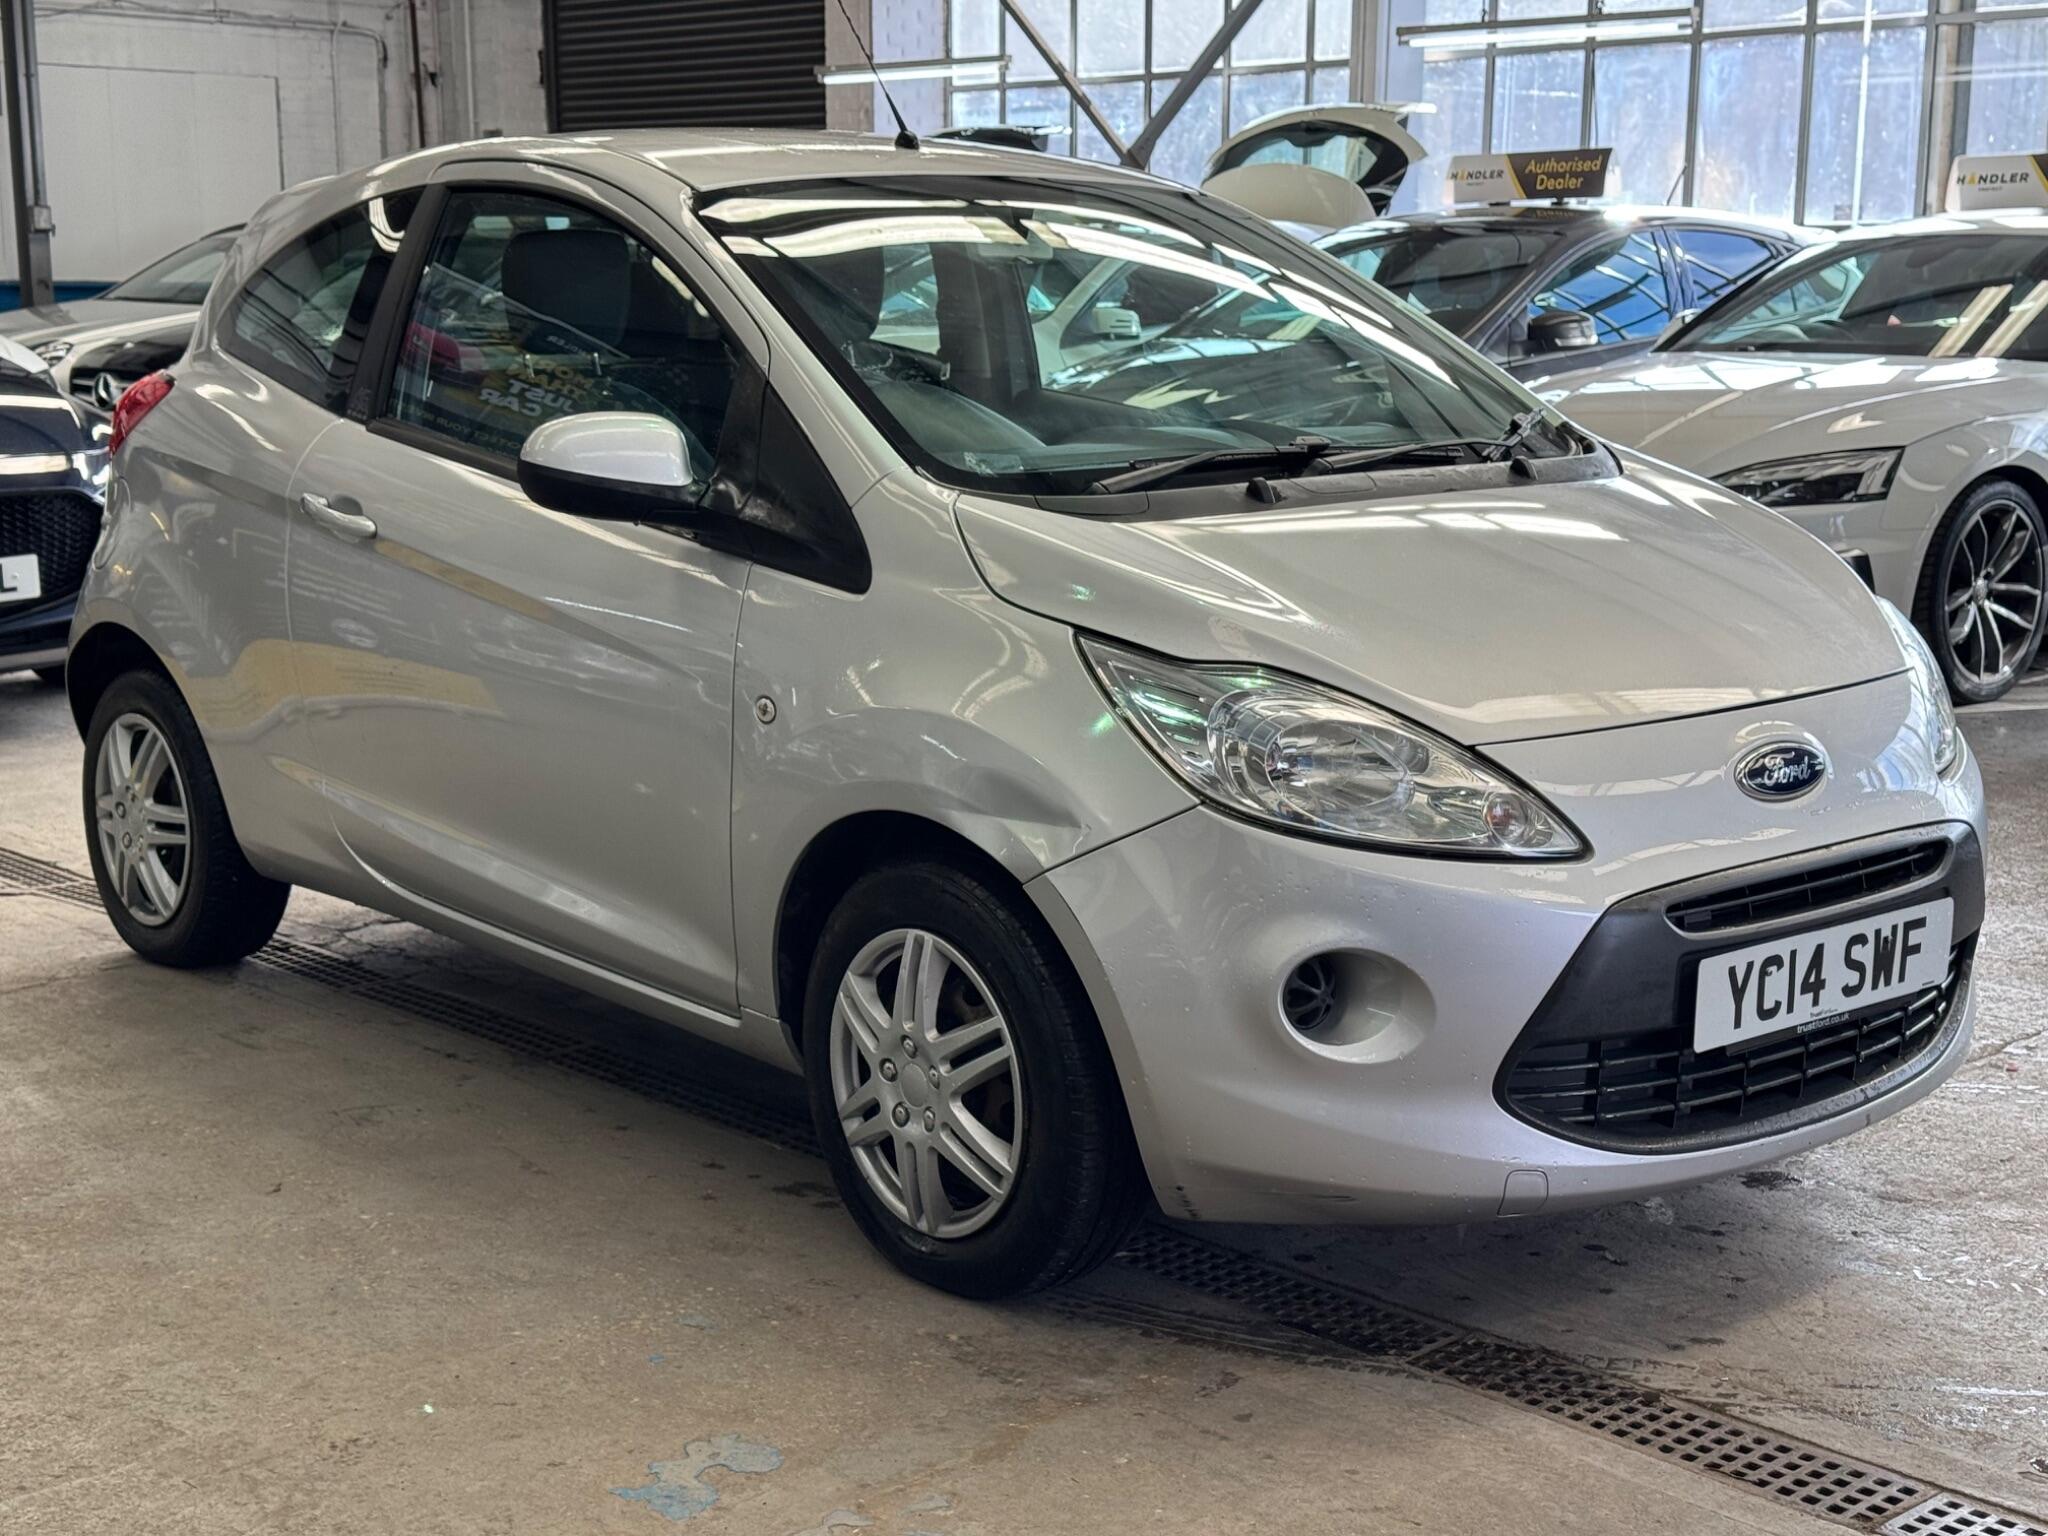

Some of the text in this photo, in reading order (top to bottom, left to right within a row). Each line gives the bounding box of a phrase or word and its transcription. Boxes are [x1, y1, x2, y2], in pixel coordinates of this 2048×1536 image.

[1525, 153, 1603, 174] Authorised
[1535, 174, 1584, 191] Dealer
[1764, 751, 1811, 787] Ford
[1728, 916, 1927, 1030] YC14 SWF
